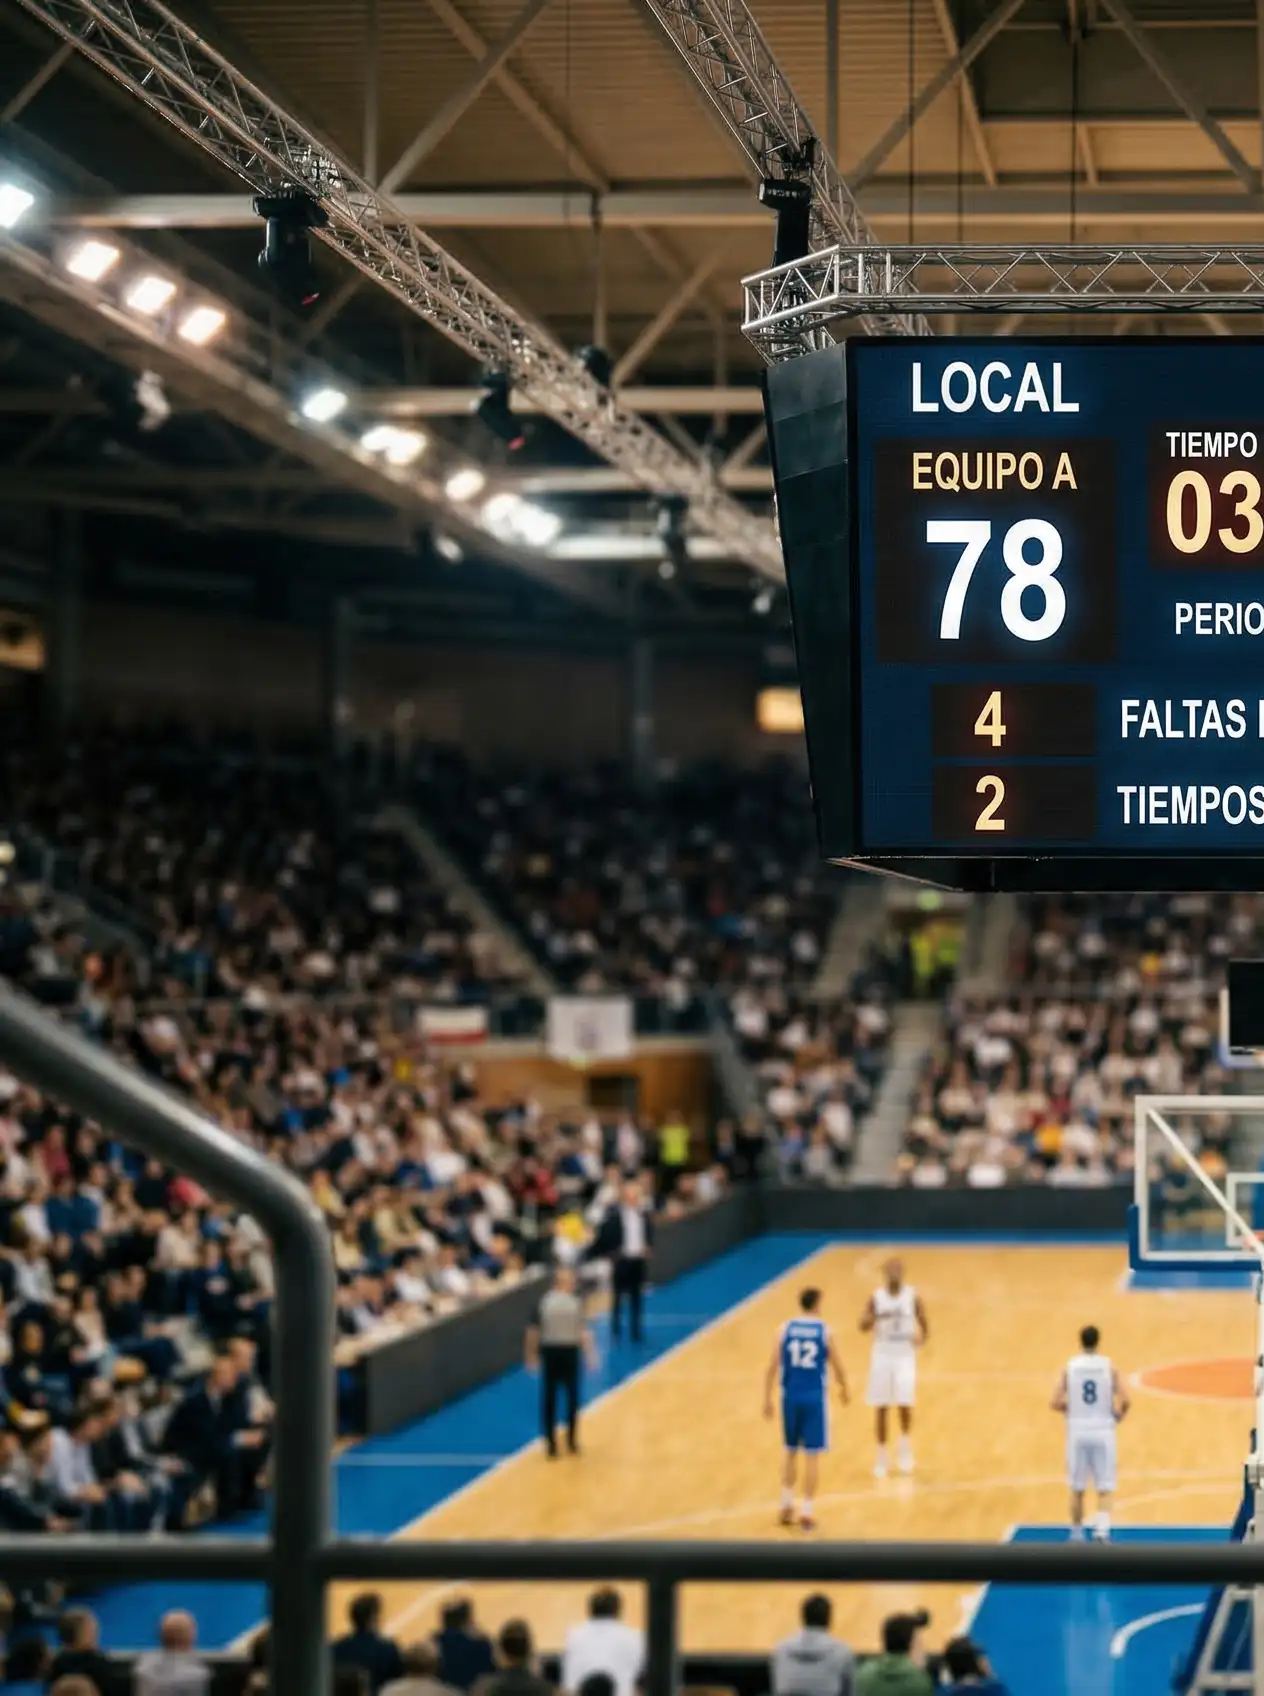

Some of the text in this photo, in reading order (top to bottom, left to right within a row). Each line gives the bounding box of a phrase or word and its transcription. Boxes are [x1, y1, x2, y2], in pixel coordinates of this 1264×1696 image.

[912, 361, 1080, 413] LOCAL
[1165, 431, 1258, 458] TIEMPO
[912, 452, 1078, 493] EQUIPO A
[925, 518, 1067, 642] 78
[974, 690, 1007, 747] 4
[1121, 698, 1247, 739] FALTAS
[974, 774, 1005, 831] 2
[788, 1341, 818, 1369] 12
[1082, 1379, 1098, 1405] 8
